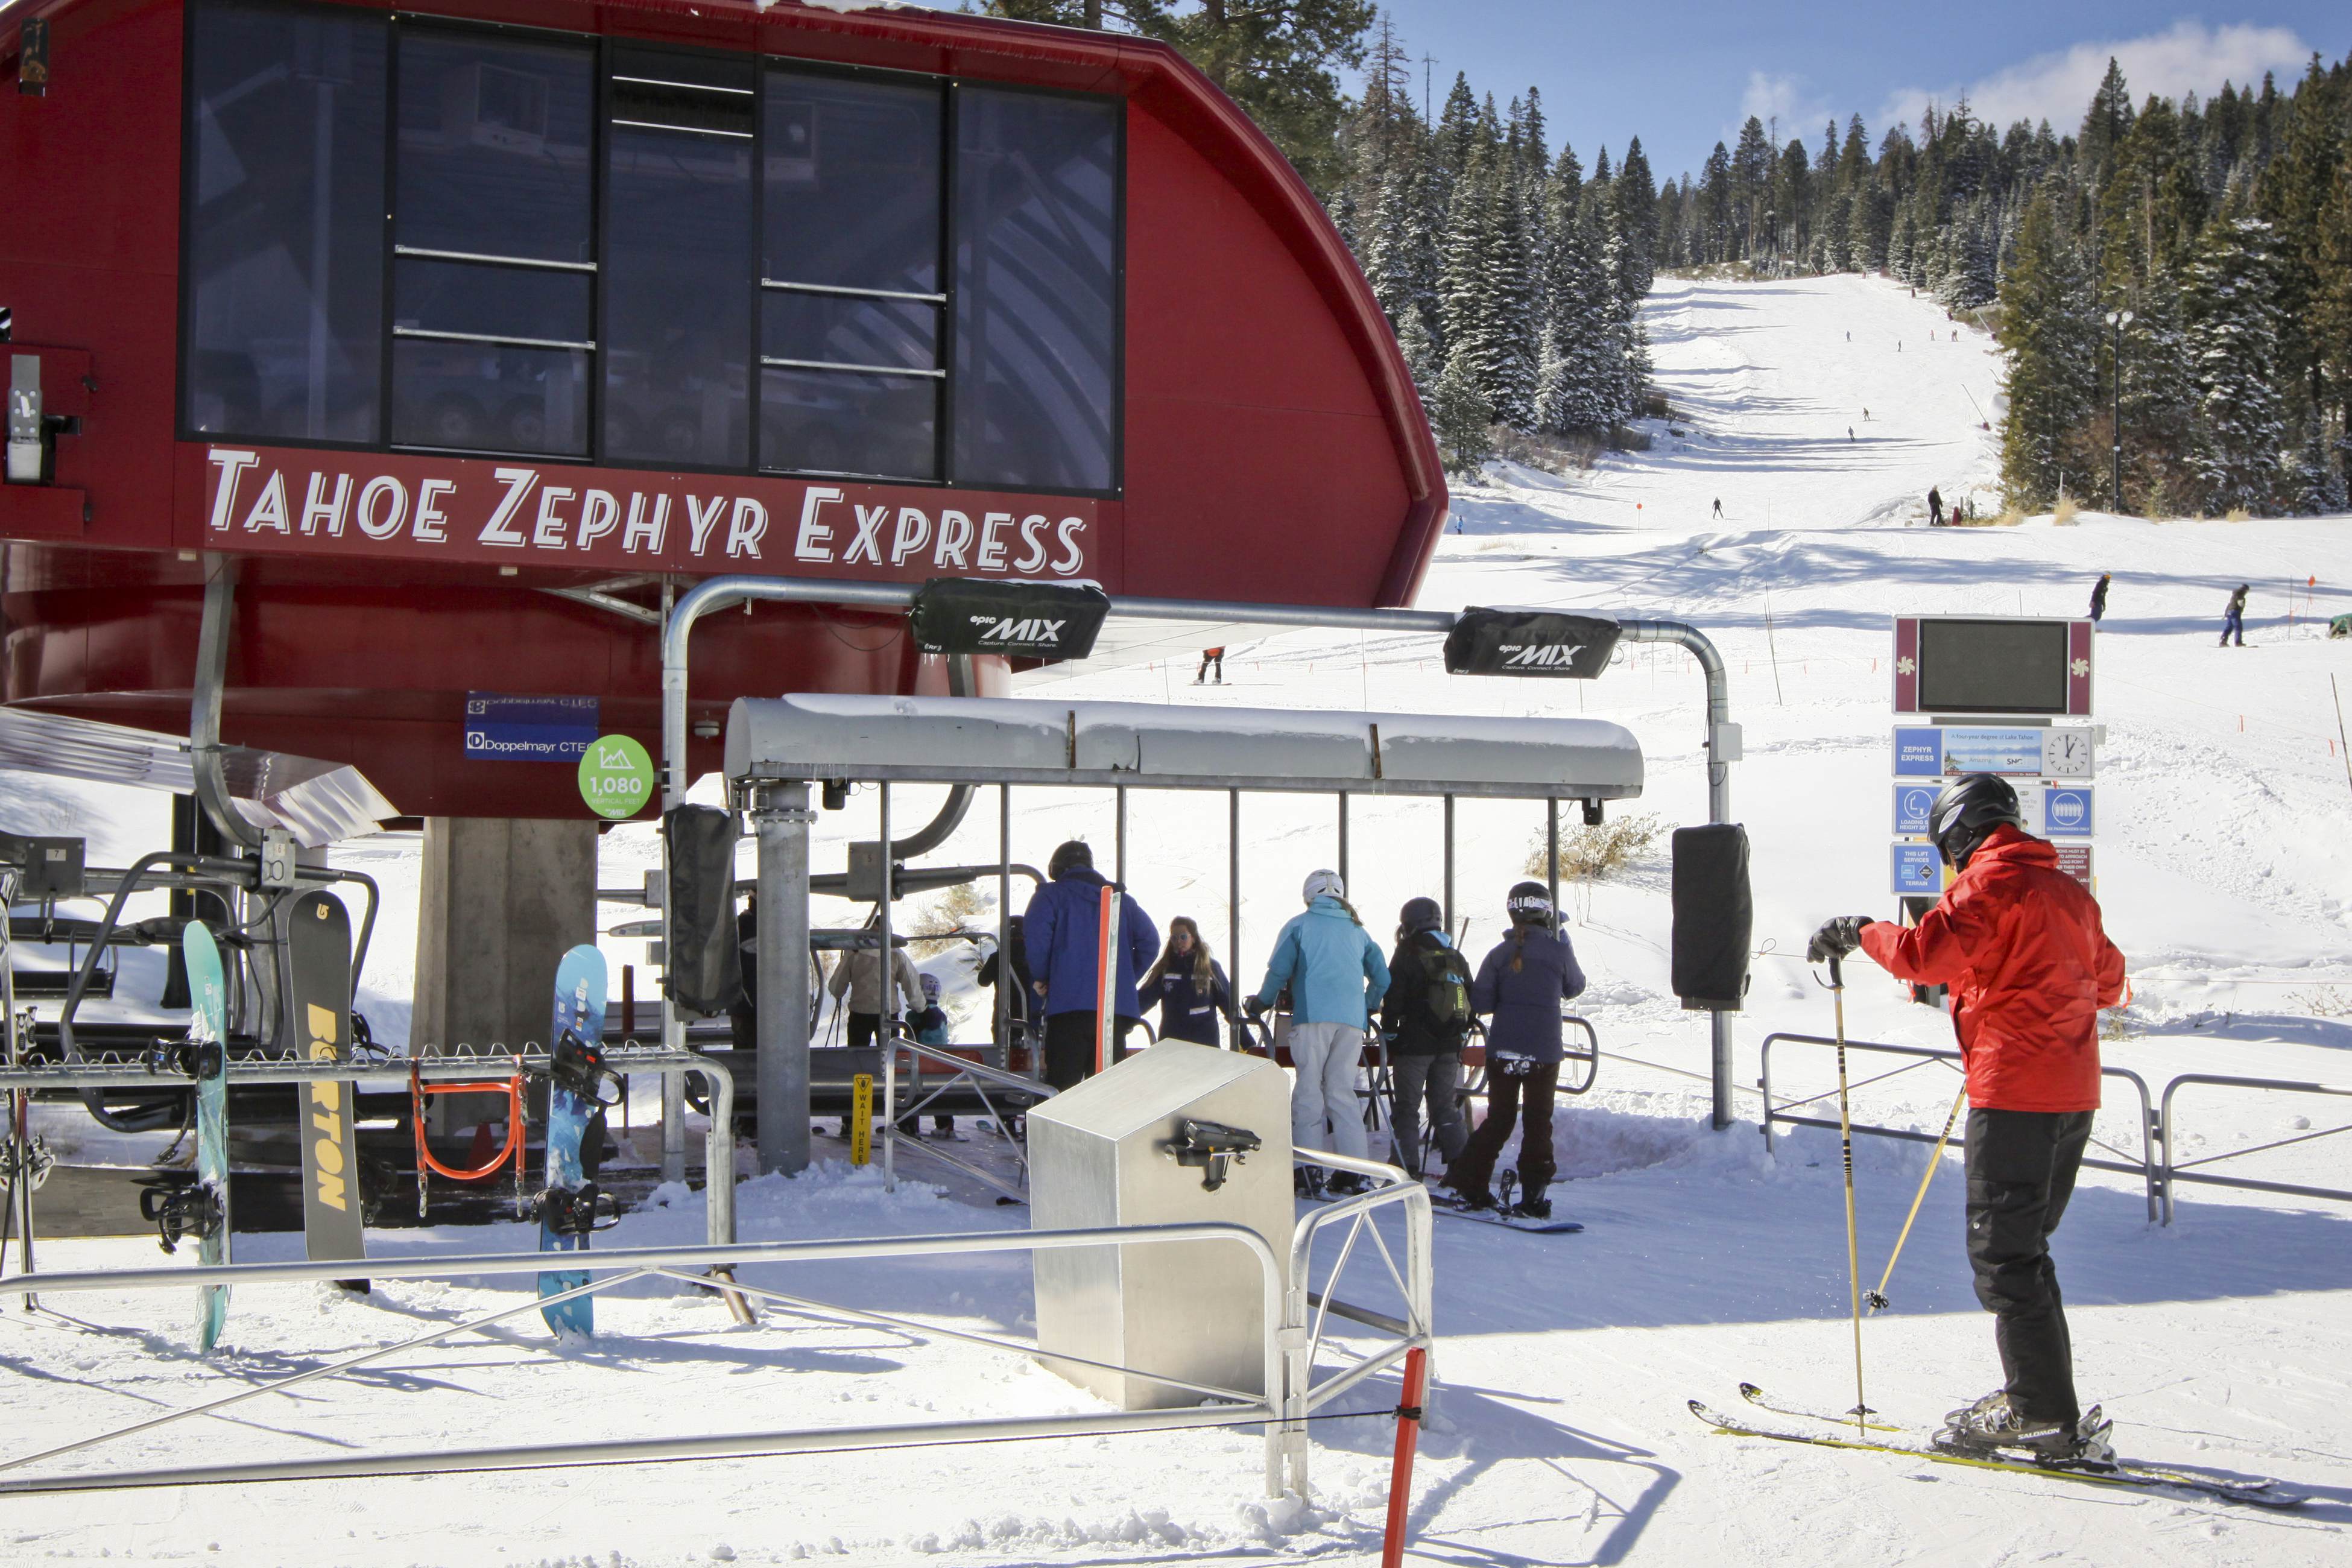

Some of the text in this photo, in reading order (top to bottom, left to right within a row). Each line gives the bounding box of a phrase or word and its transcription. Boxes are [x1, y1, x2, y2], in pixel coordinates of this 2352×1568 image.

[208, 449, 1087, 576] TAHOE ZEPHYR EXPRESS
[485, 740, 556, 753] Doppelmayr
[590, 777, 642, 796] 1,080
[54, 850, 59, 858] 7
[2017, 1427, 2061, 1440] SALOMON
